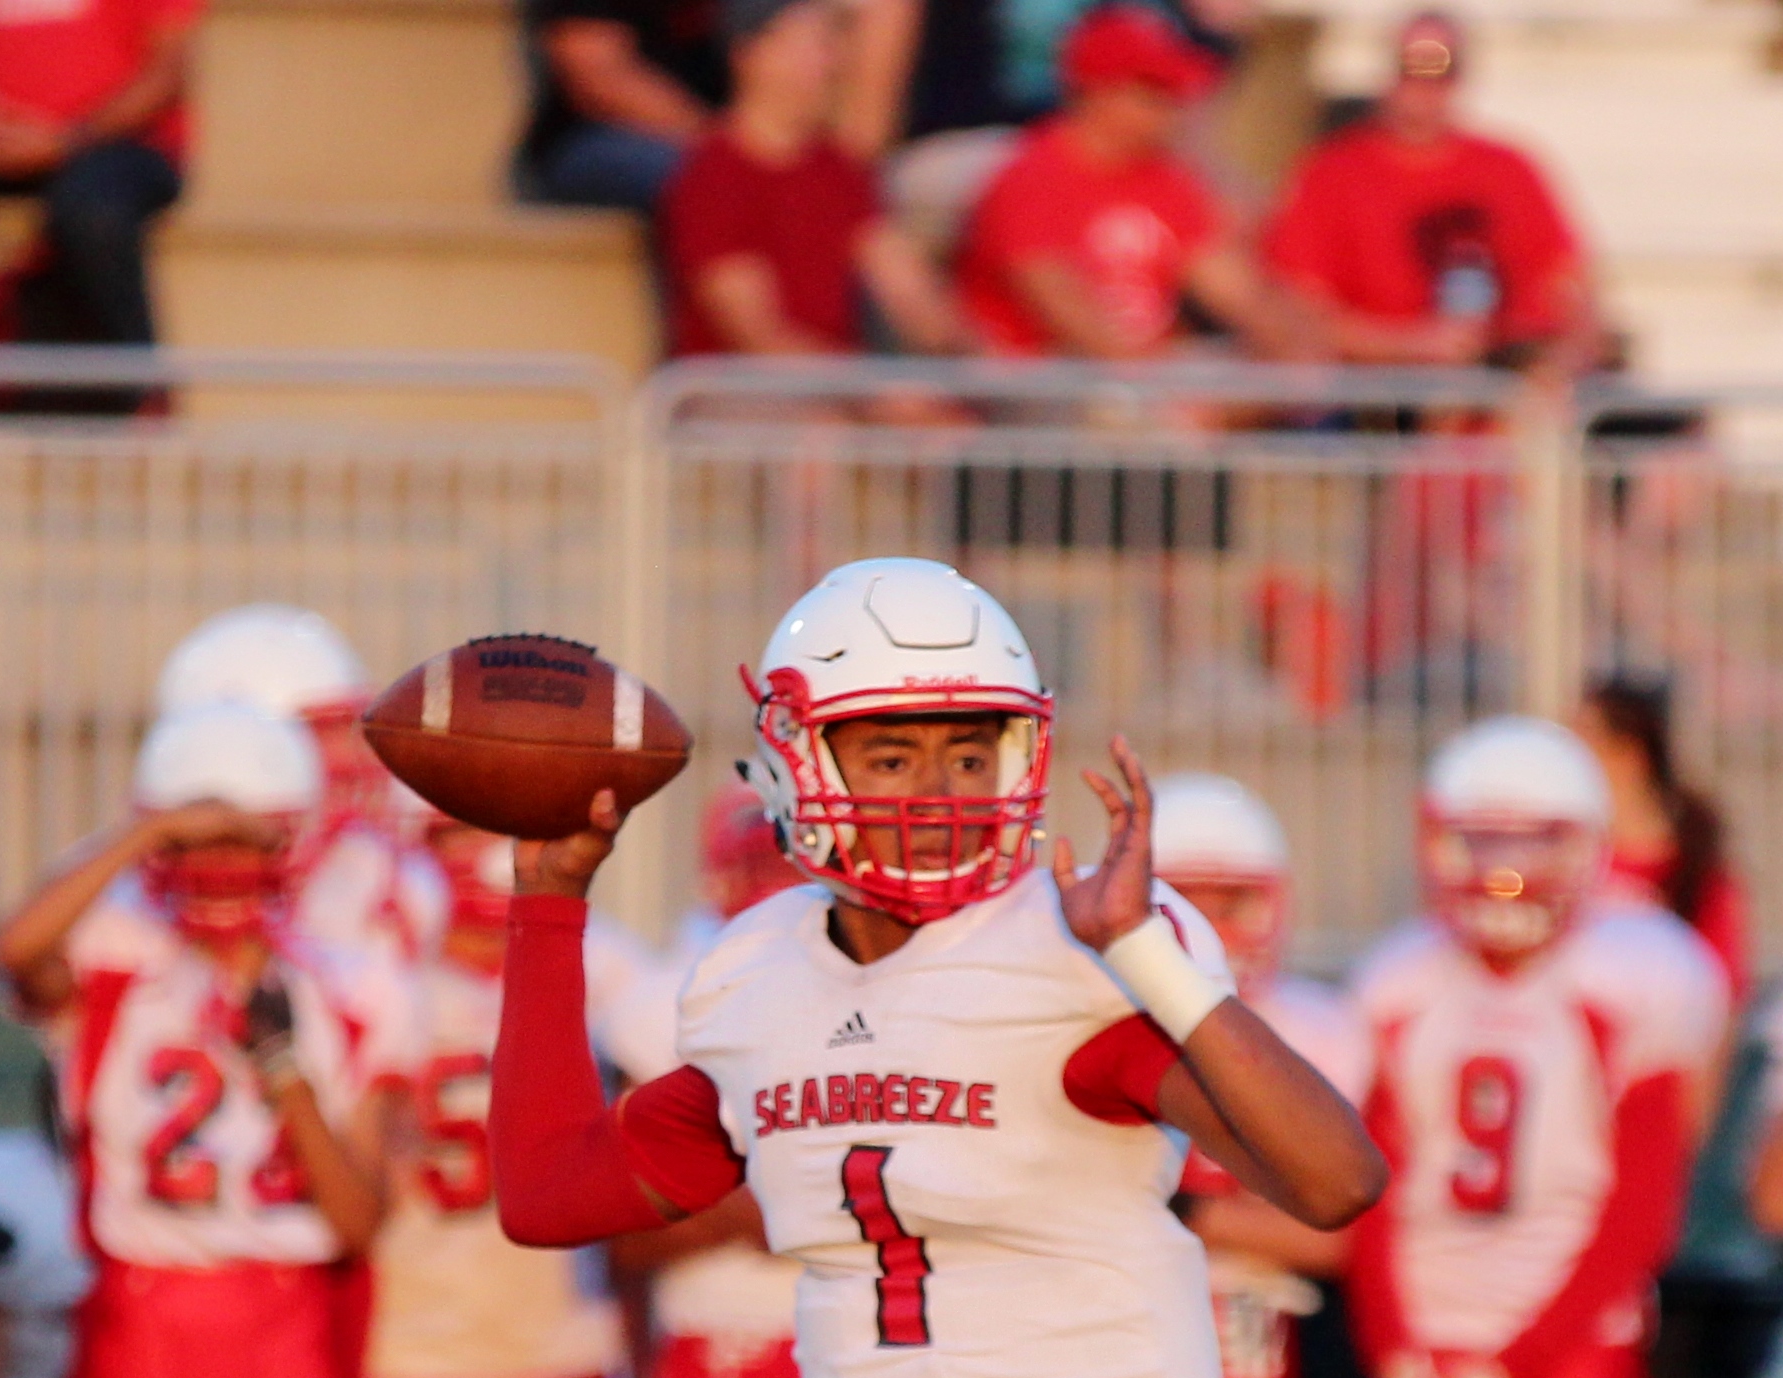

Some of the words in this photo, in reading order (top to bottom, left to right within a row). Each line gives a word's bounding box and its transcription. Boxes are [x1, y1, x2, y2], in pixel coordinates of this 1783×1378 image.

[755, 1073, 997, 1138] SEABREEZE
[1452, 1055, 1526, 1215] 9
[841, 1144, 933, 1347] 1
